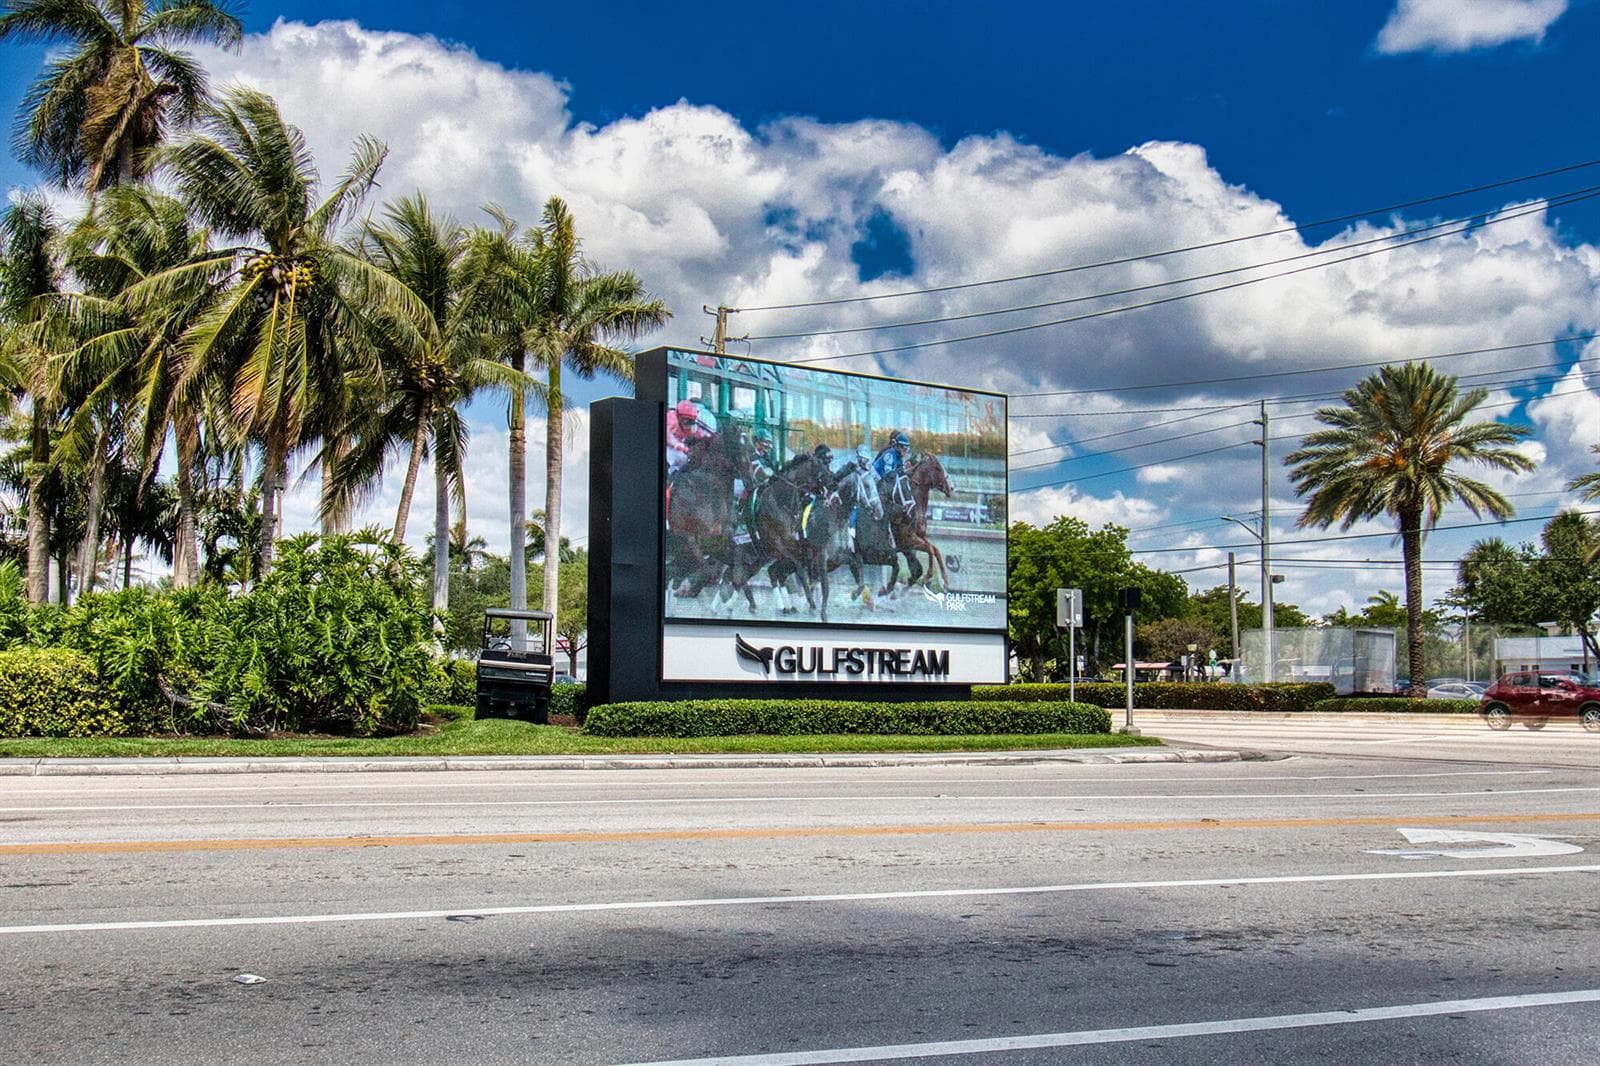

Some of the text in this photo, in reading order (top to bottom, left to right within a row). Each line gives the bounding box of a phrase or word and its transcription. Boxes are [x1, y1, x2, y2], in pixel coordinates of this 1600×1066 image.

[946, 592, 995, 604] GULFSTREAM
[946, 601, 967, 611] PARK
[774, 646, 950, 675] GULFSTREAM
